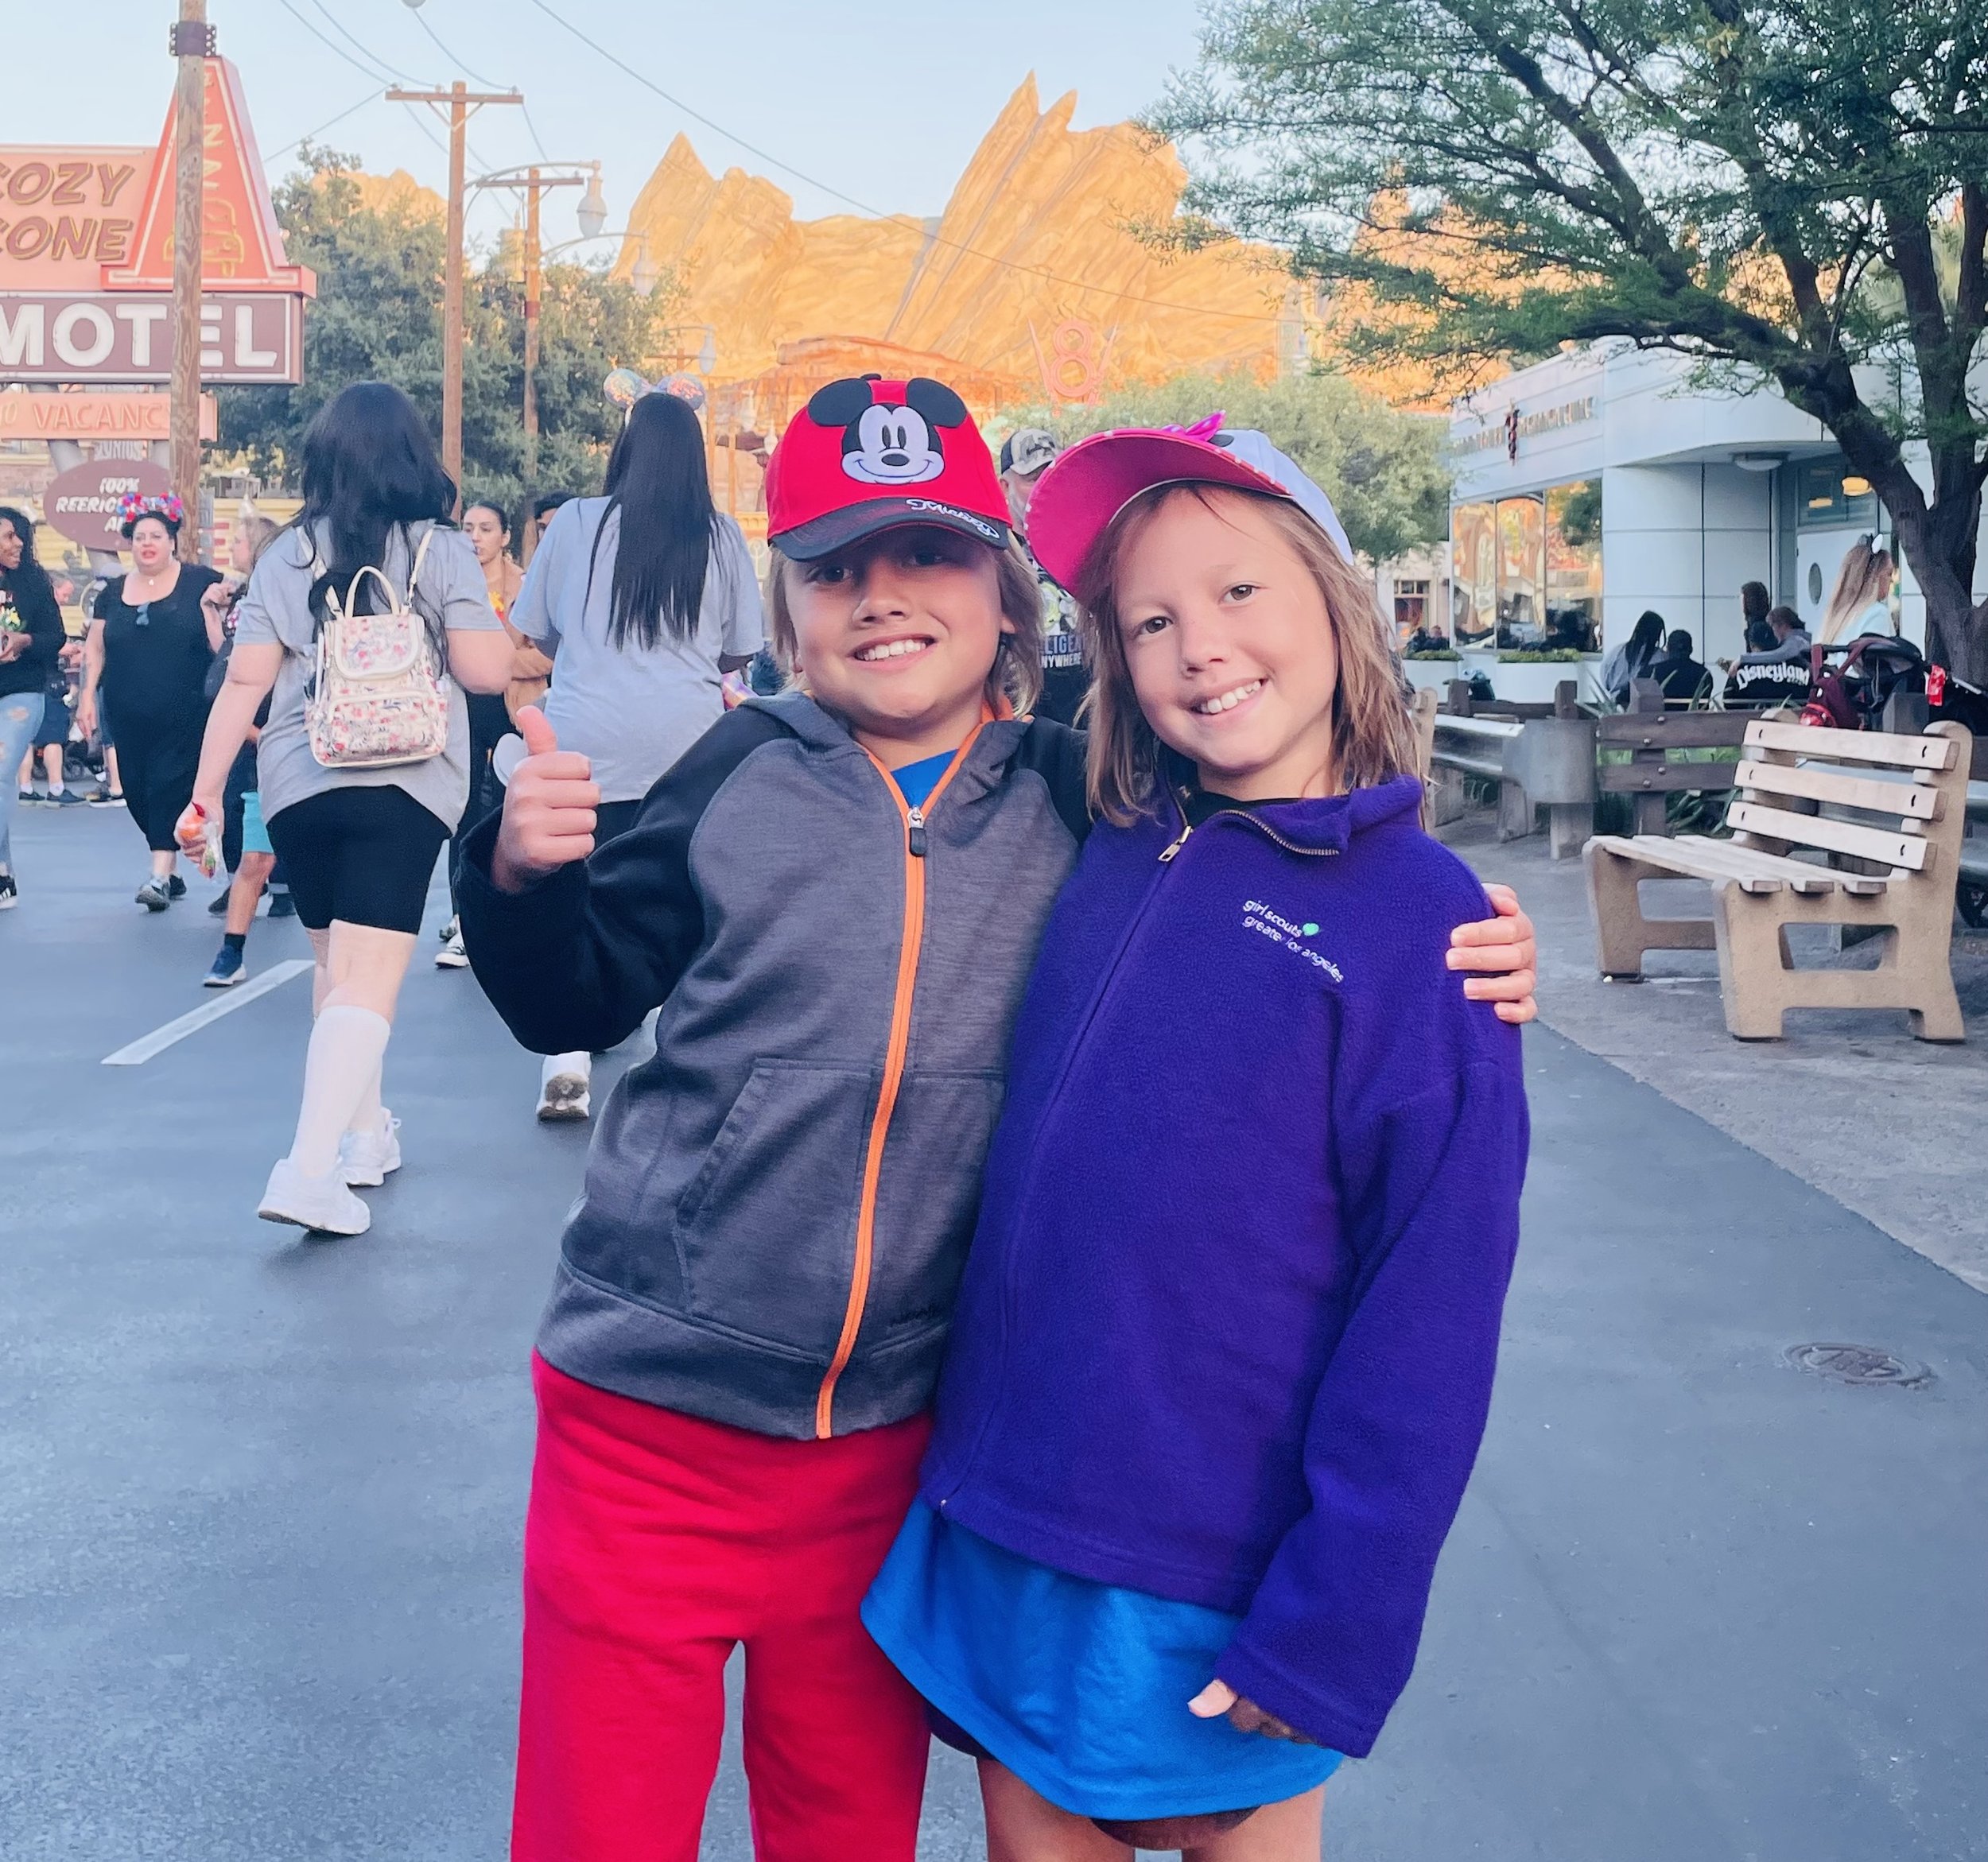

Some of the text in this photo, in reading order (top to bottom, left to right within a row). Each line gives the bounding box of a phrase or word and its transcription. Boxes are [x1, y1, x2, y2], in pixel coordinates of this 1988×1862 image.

[0, 302, 278, 367] MOTEL
[33, 402, 170, 431] VACANC
[99, 476, 140, 495] 100%
[104, 517, 123, 533] AI
[906, 498, 1000, 539] Mickey
[1039, 651, 1082, 669] NYWHERE
[1736, 661, 1810, 691] Disneyland
[1242, 900, 1303, 938] girl scouts
[1242, 916, 1344, 983] greater los angeles
